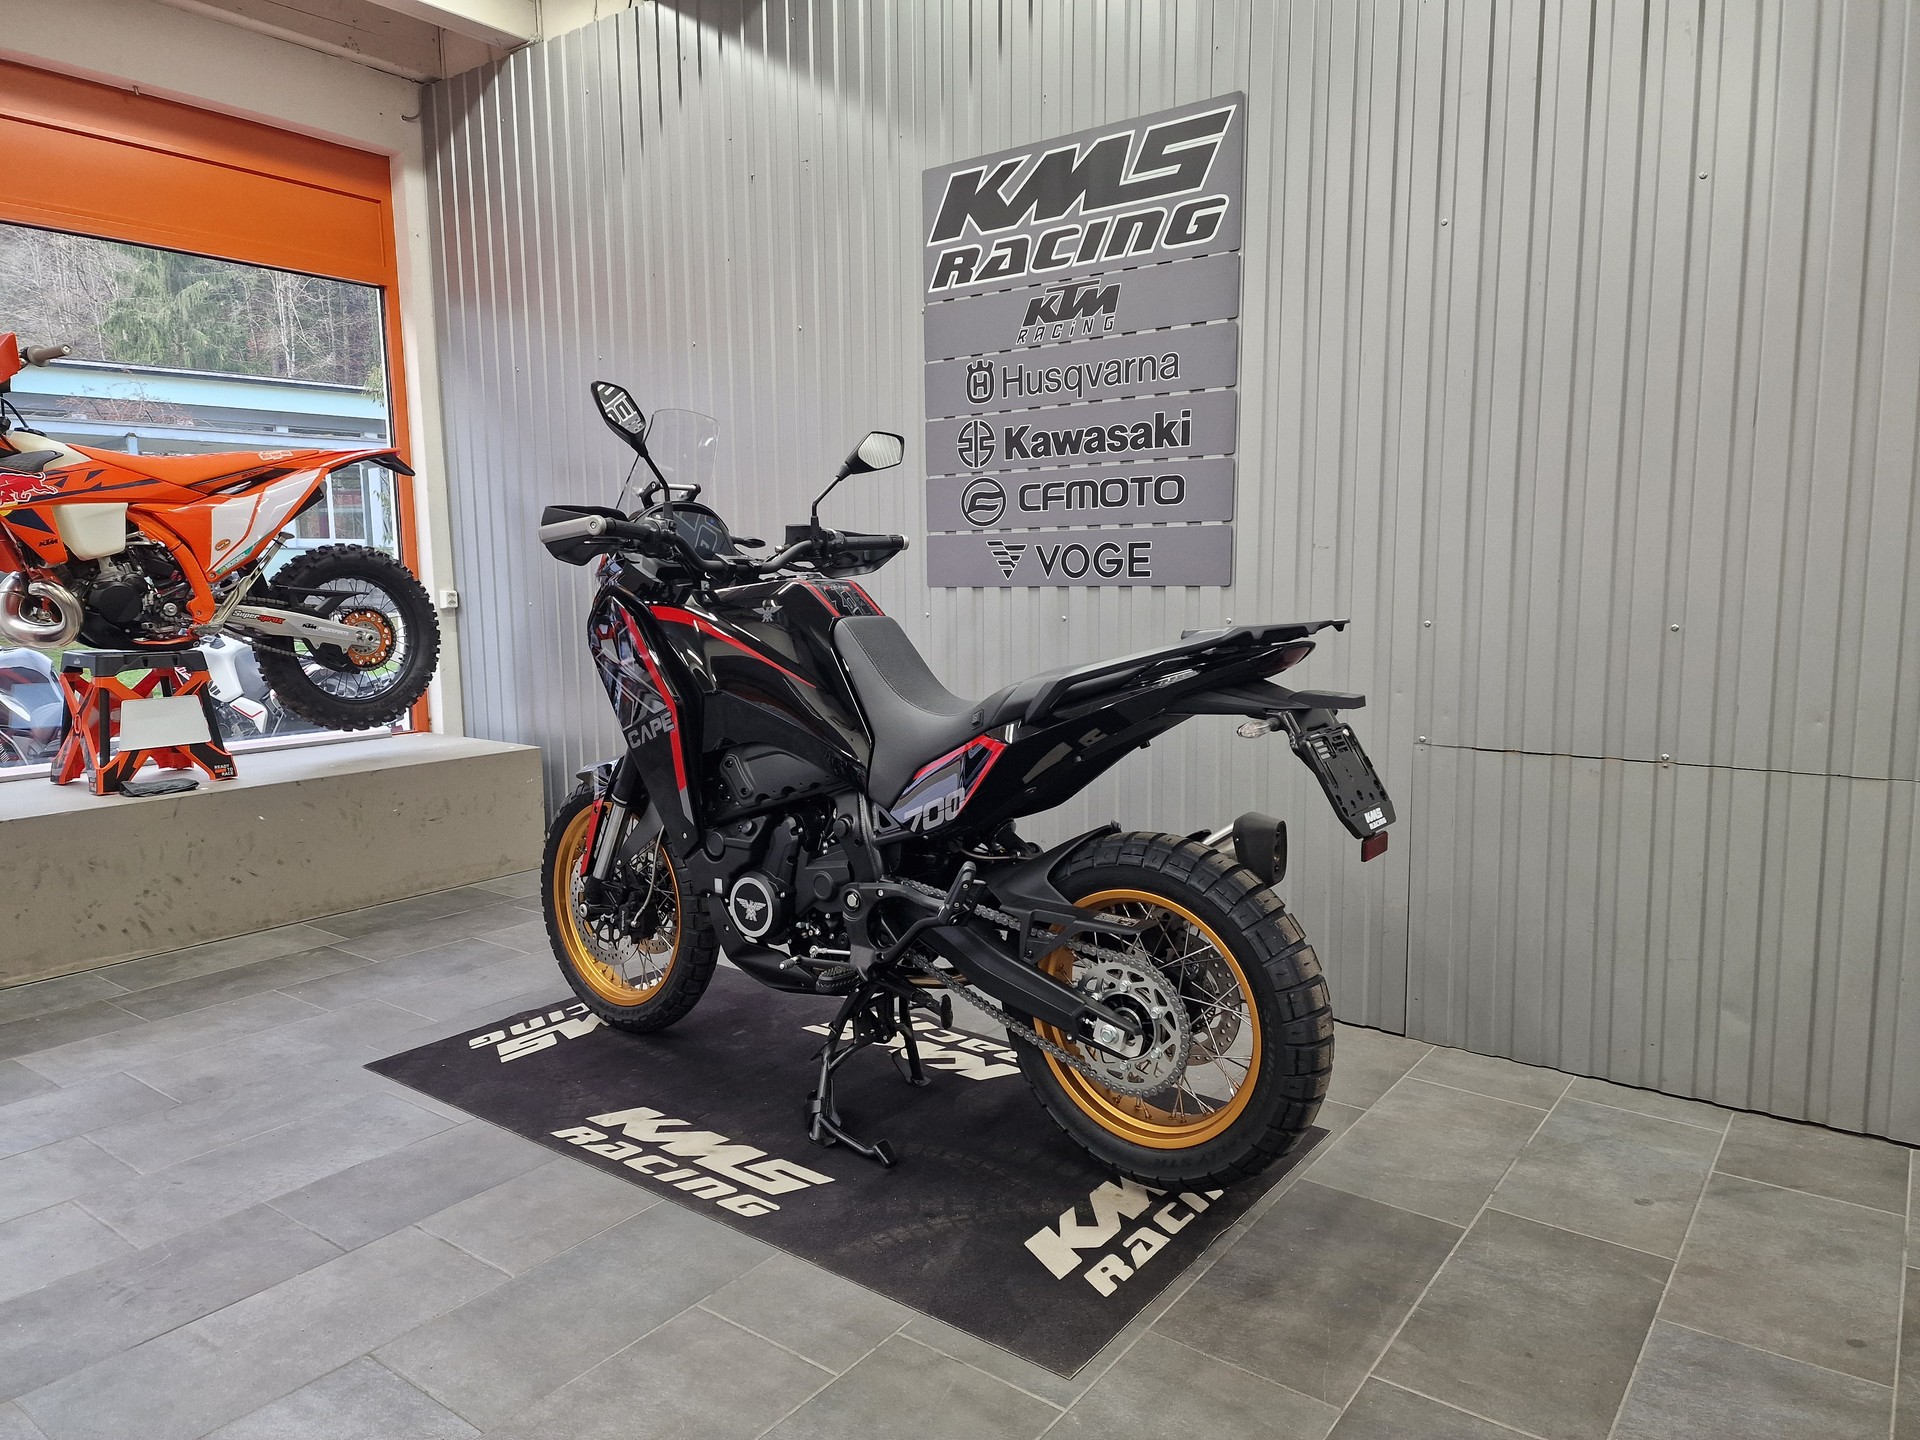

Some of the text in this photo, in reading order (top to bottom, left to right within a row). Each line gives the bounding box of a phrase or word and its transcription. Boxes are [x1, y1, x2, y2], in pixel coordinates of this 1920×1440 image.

[926, 104, 1237, 247] KMS
[928, 193, 1230, 293] RACING
[1021, 278, 1122, 328] KTM
[1001, 351, 1181, 399] Husqvarna
[1003, 408, 1192, 461] Kawasaki
[1018, 474, 1187, 513] CFMOTO
[1035, 541, 1153, 579] VOGE
[627, 711, 676, 749] CAPE
[903, 787, 966, 833] 700
[550, 1126, 781, 1218] RACING
[585, 1106, 836, 1195] KMS
[1023, 1175, 1169, 1281] KM
